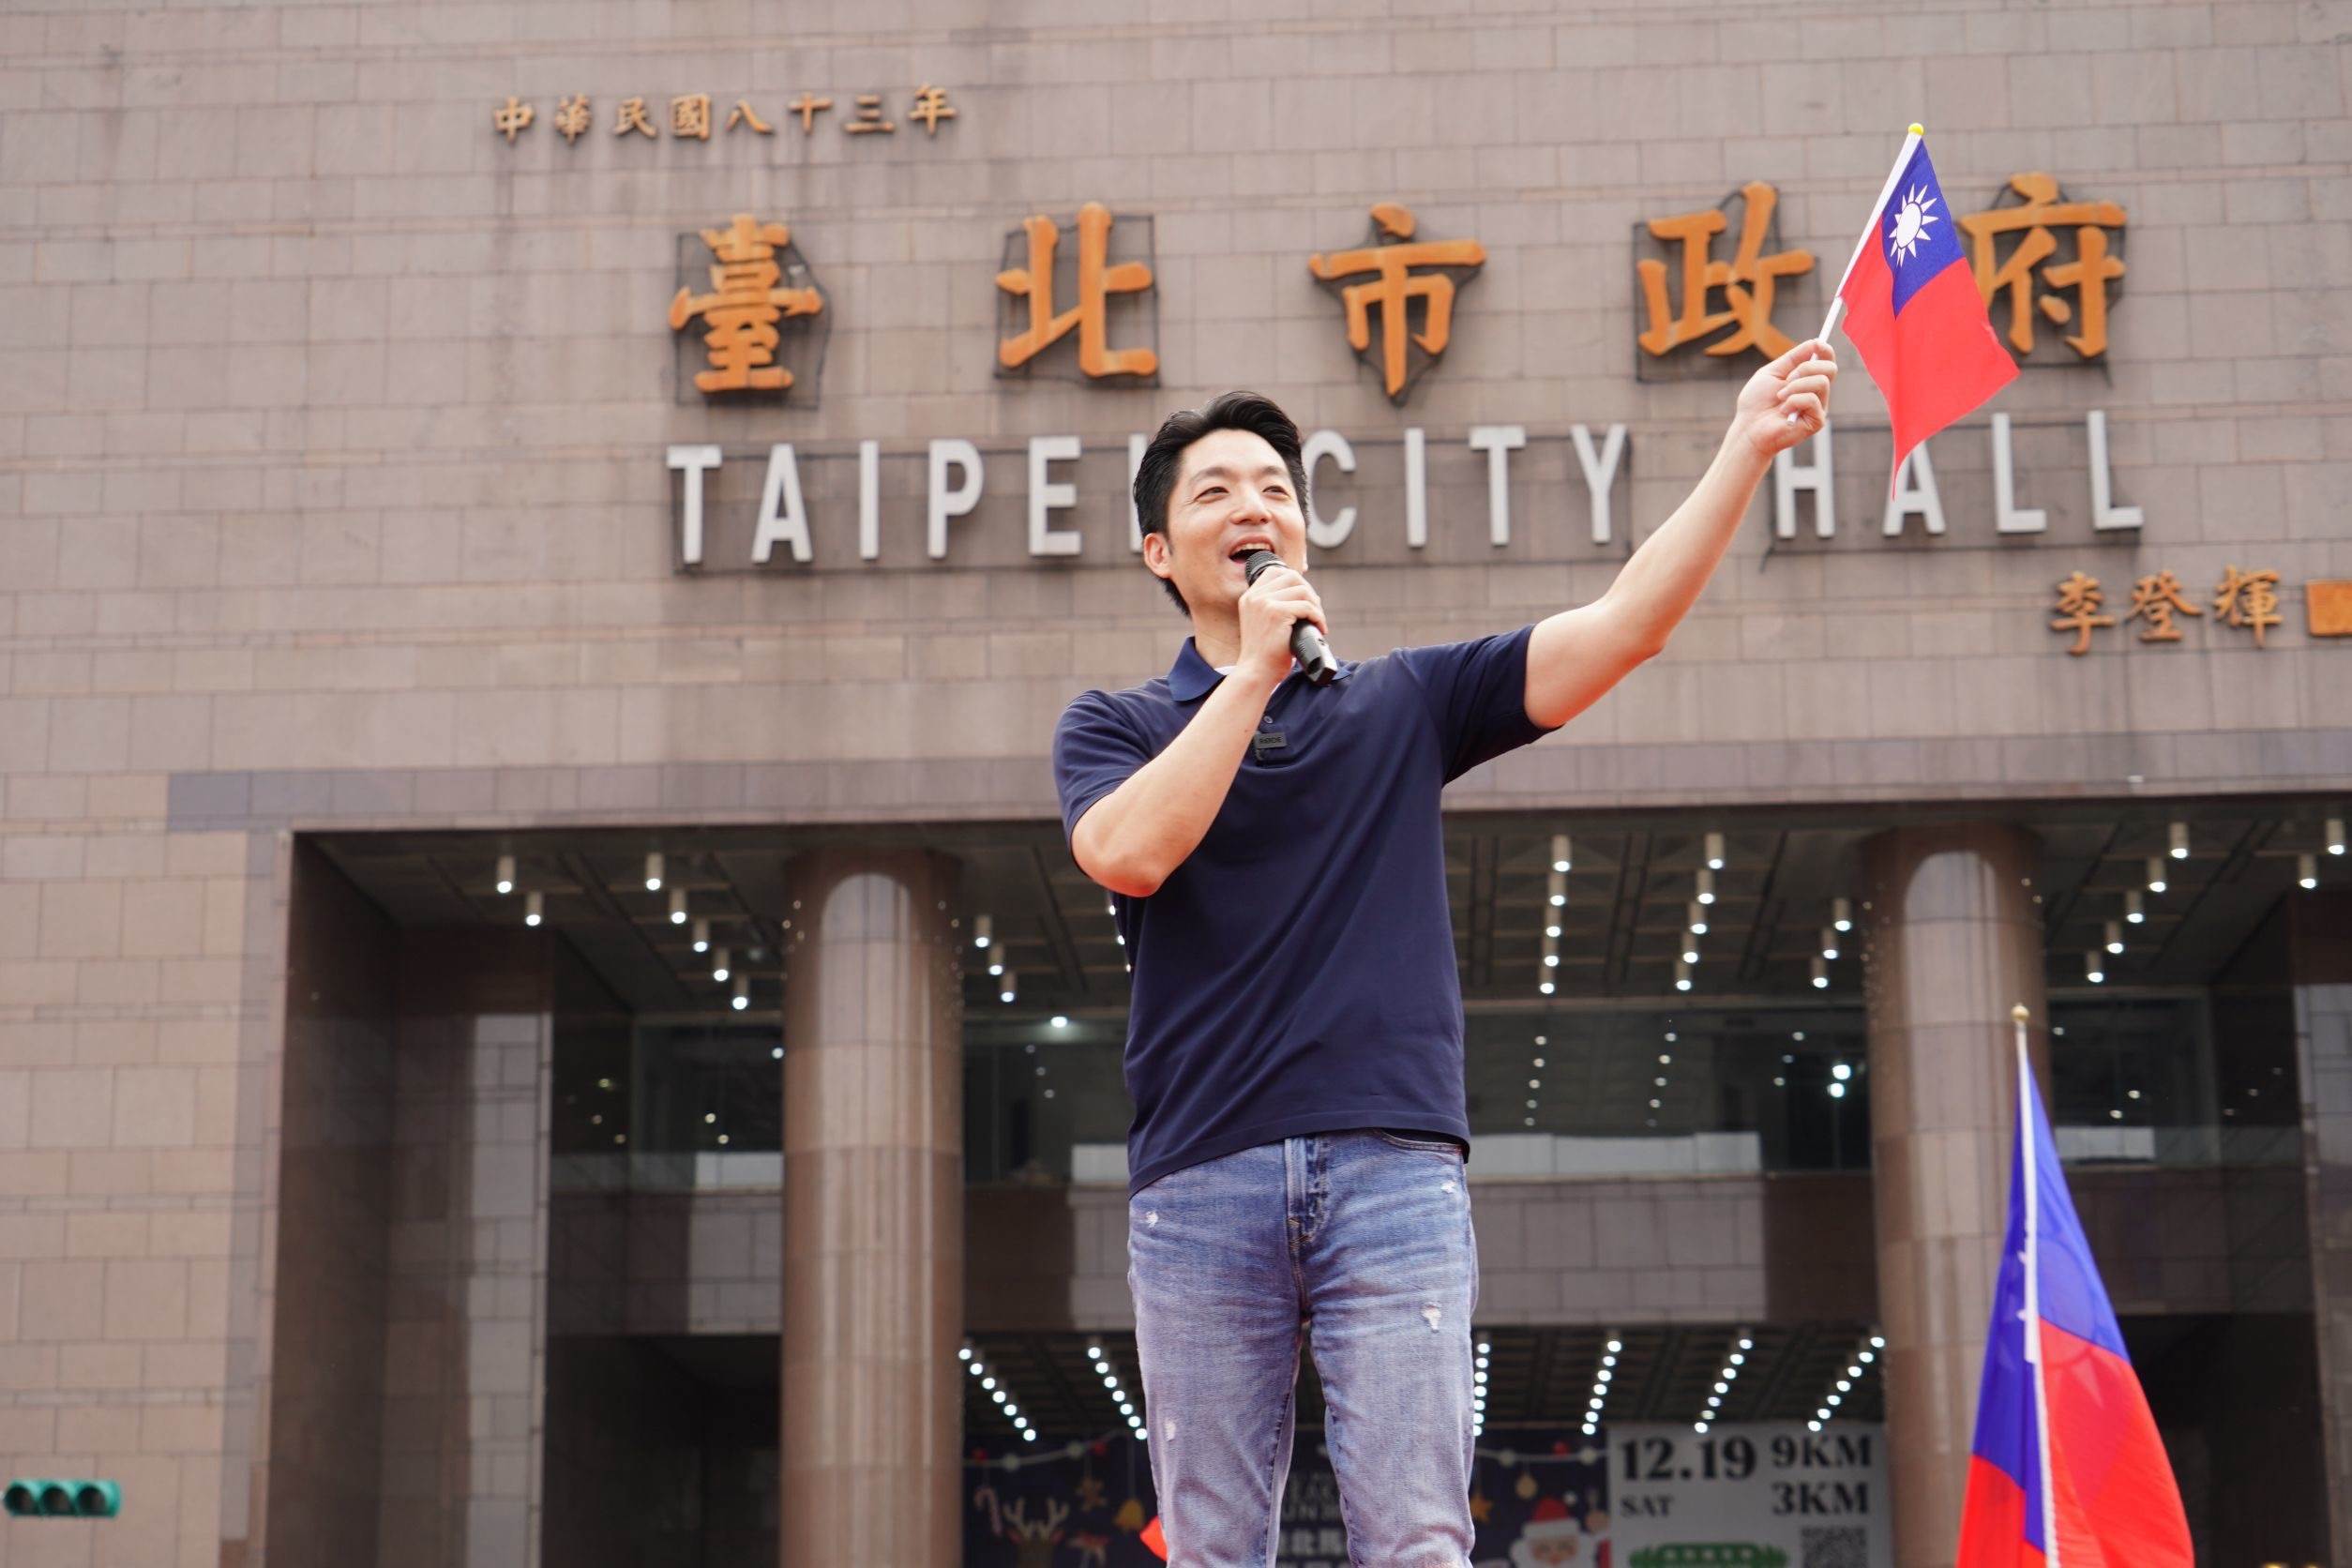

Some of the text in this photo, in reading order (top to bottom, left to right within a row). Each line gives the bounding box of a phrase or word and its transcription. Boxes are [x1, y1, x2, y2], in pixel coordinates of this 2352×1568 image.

[494, 84, 957, 142] 中華民國八十三年
[668, 172, 2127, 396] 臺北市政府
[1301, 424, 1628, 548] CITY
[1775, 411, 2144, 538] HALL
[2051, 568, 2284, 654] 李登輝
[1621, 1437, 1756, 1480] 12.19
[1772, 1436, 1872, 1468] 9KM
[1621, 1494, 1675, 1516] SAT
[1772, 1482, 1870, 1515] 3KM
